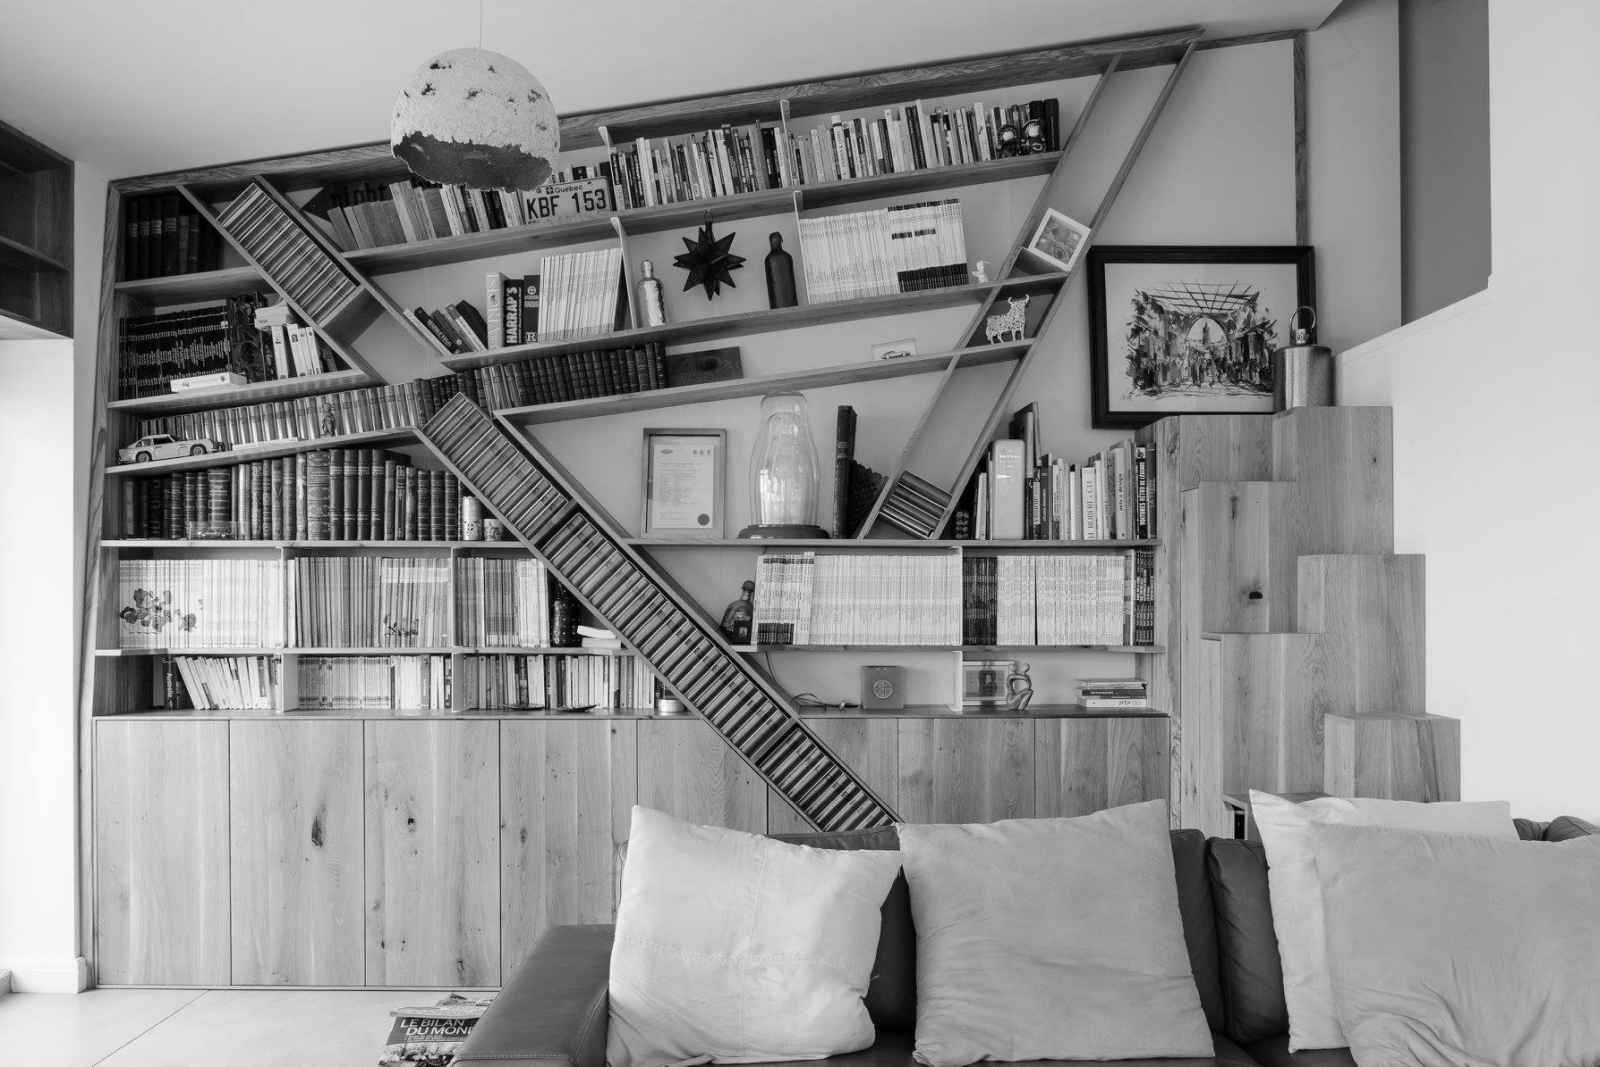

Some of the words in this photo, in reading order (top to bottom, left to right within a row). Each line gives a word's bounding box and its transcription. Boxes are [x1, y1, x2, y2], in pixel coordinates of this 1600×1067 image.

[526, 195, 560, 219] KBF
[571, 189, 607, 213] 153
[505, 286, 518, 344] HARRAP'S
[400, 1019, 419, 1028] LE
[420, 1018, 466, 1027] BILAN
[405, 1027, 430, 1036] DU
